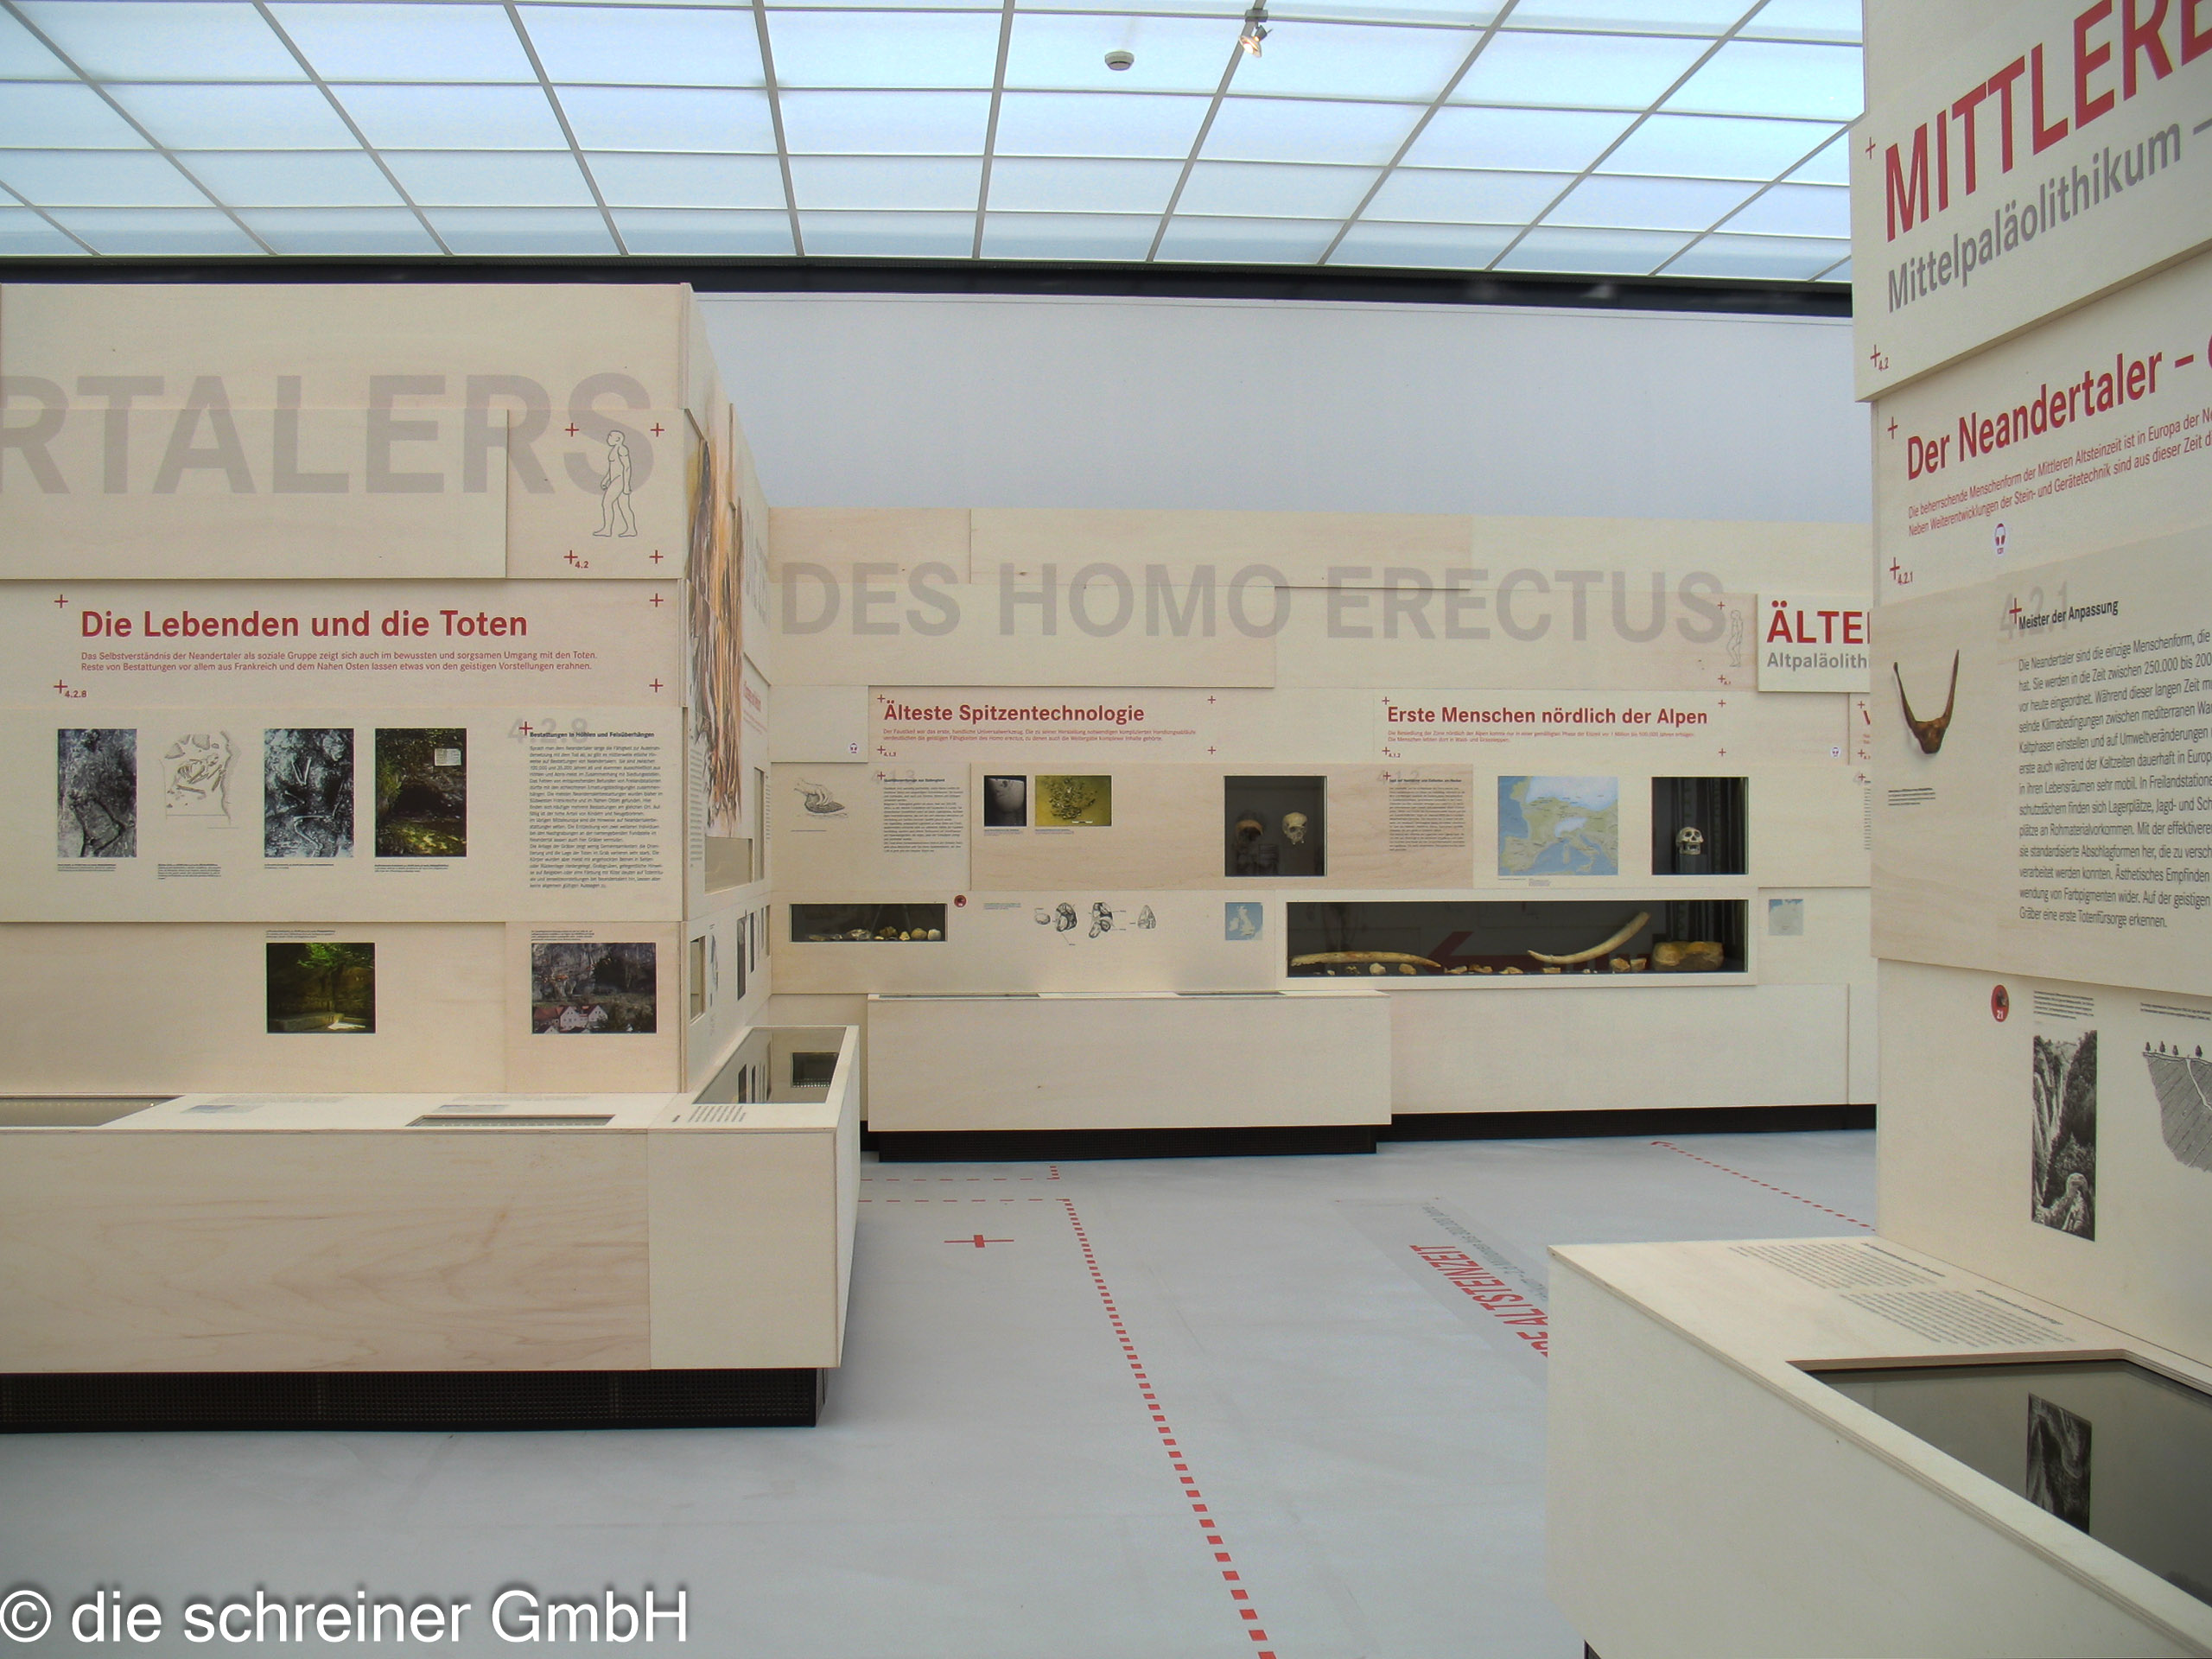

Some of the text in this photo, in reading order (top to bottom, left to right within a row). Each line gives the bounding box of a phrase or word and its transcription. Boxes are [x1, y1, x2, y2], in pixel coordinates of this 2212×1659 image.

[1889, 124, 2181, 313] Mittelpaläolithikum
[1878, 357, 1889, 372] 4.2
[1908, 435, 1950, 480] Der
[1959, 352, 2163, 463] Neandertaler
[0, 372, 655, 495] RTALERS
[1909, 415, 2199, 519] Die beherrschende Menschenform der Mittleren Altsteinzeit ist in Europa der
[575, 560, 589, 569] 4.2
[1897, 572, 1913, 585] 4.2.1
[781, 562, 1726, 645] DES HOMO ERECTUS
[2018, 601, 2118, 630] Meister der Anpassung
[83, 610, 526, 638] Die Lebenden und die Toten
[1767, 601, 1870, 645] ÄLTE
[82, 663, 104, 671] Reste
[124, 663, 176, 673] Bestattungen
[235, 662, 276, 671] Frankreich
[346, 662, 369, 671] Osten
[460, 662, 496, 672] geistigen
[499, 662, 554, 672] Vorstellungen
[189, 652, 241, 660] Neandertaler
[244, 652, 255, 660] als
[257, 652, 285, 660] soziale
[288, 652, 317, 661] Gruppe
[320, 652, 338, 661] zeigt
[458, 652, 501, 661] sorgsamen
[504, 652, 537, 661] Umgang
[574, 651, 598, 659] Toten.
[884, 700, 1145, 725] Älteste Spitzentechnologie
[1389, 707, 1707, 728] Erste Menschen nördlich der Alpen
[1409, 1245, 1548, 1326] ALTSTEINZEIT
